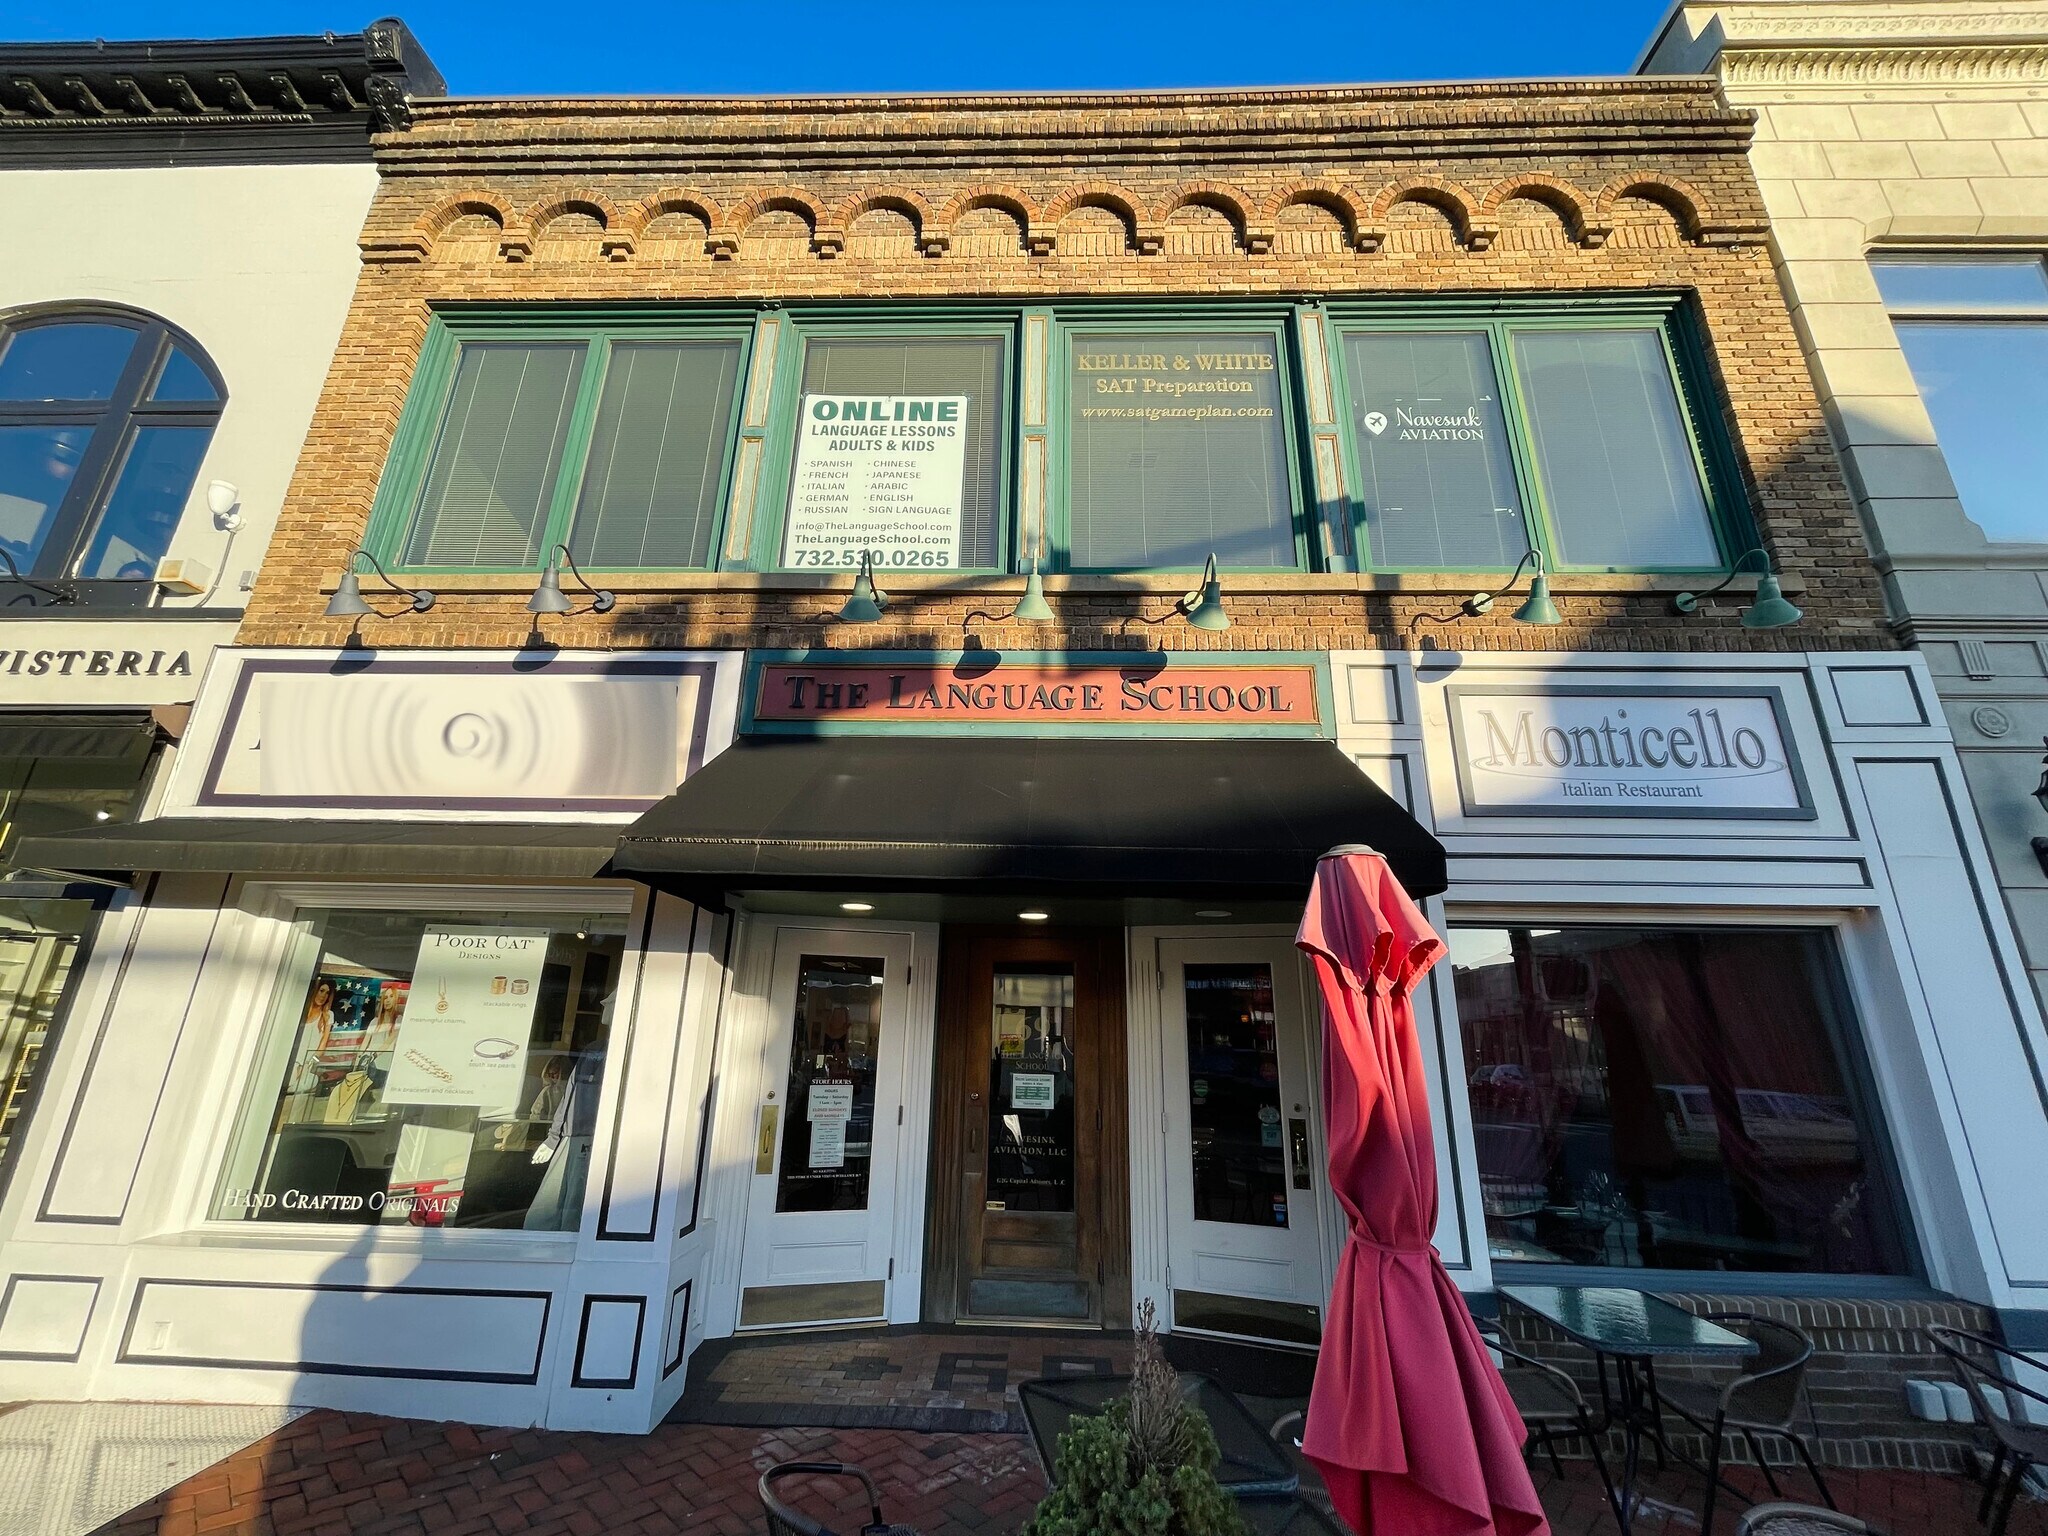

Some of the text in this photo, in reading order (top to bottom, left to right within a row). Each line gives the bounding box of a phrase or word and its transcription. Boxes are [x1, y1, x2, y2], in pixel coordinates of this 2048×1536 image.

[1078, 354, 1274, 370] KELLER & WHITE
[1096, 378, 1253, 397] SAT Preparation
[812, 400, 958, 421] ONLINE
[1081, 405, 1273, 420] www.satgameplan.com
[1396, 407, 1482, 426] Navesink
[812, 425, 956, 437] LANGUAGE LESSONS
[1400, 429, 1484, 440] AVIATION
[829, 440, 935, 451] ADULTS & KIDS
[810, 460, 853, 468] SPANISH
[804, 506, 848, 514] RUSSIAN
[868, 506, 952, 515] SIGN LANGUAGE
[795, 522, 952, 532] info@TheLanguageSchool.com
[795, 534, 951, 545] TheLanguageSchool.com
[784, 674, 1293, 712] THE LANGUAGE SCHOOL
[1478, 709, 1766, 769] Monticello
[1562, 782, 1703, 798] Italian Restaurant
[435, 933, 487, 948] POOR
[459, 951, 501, 959] DESIGNS
[1006, 1135, 1056, 1144] NVESINK
[1049, 1148, 1067, 1156] LLC
[223, 1189, 459, 1212] HAND CRAFTED ORIGINALS
